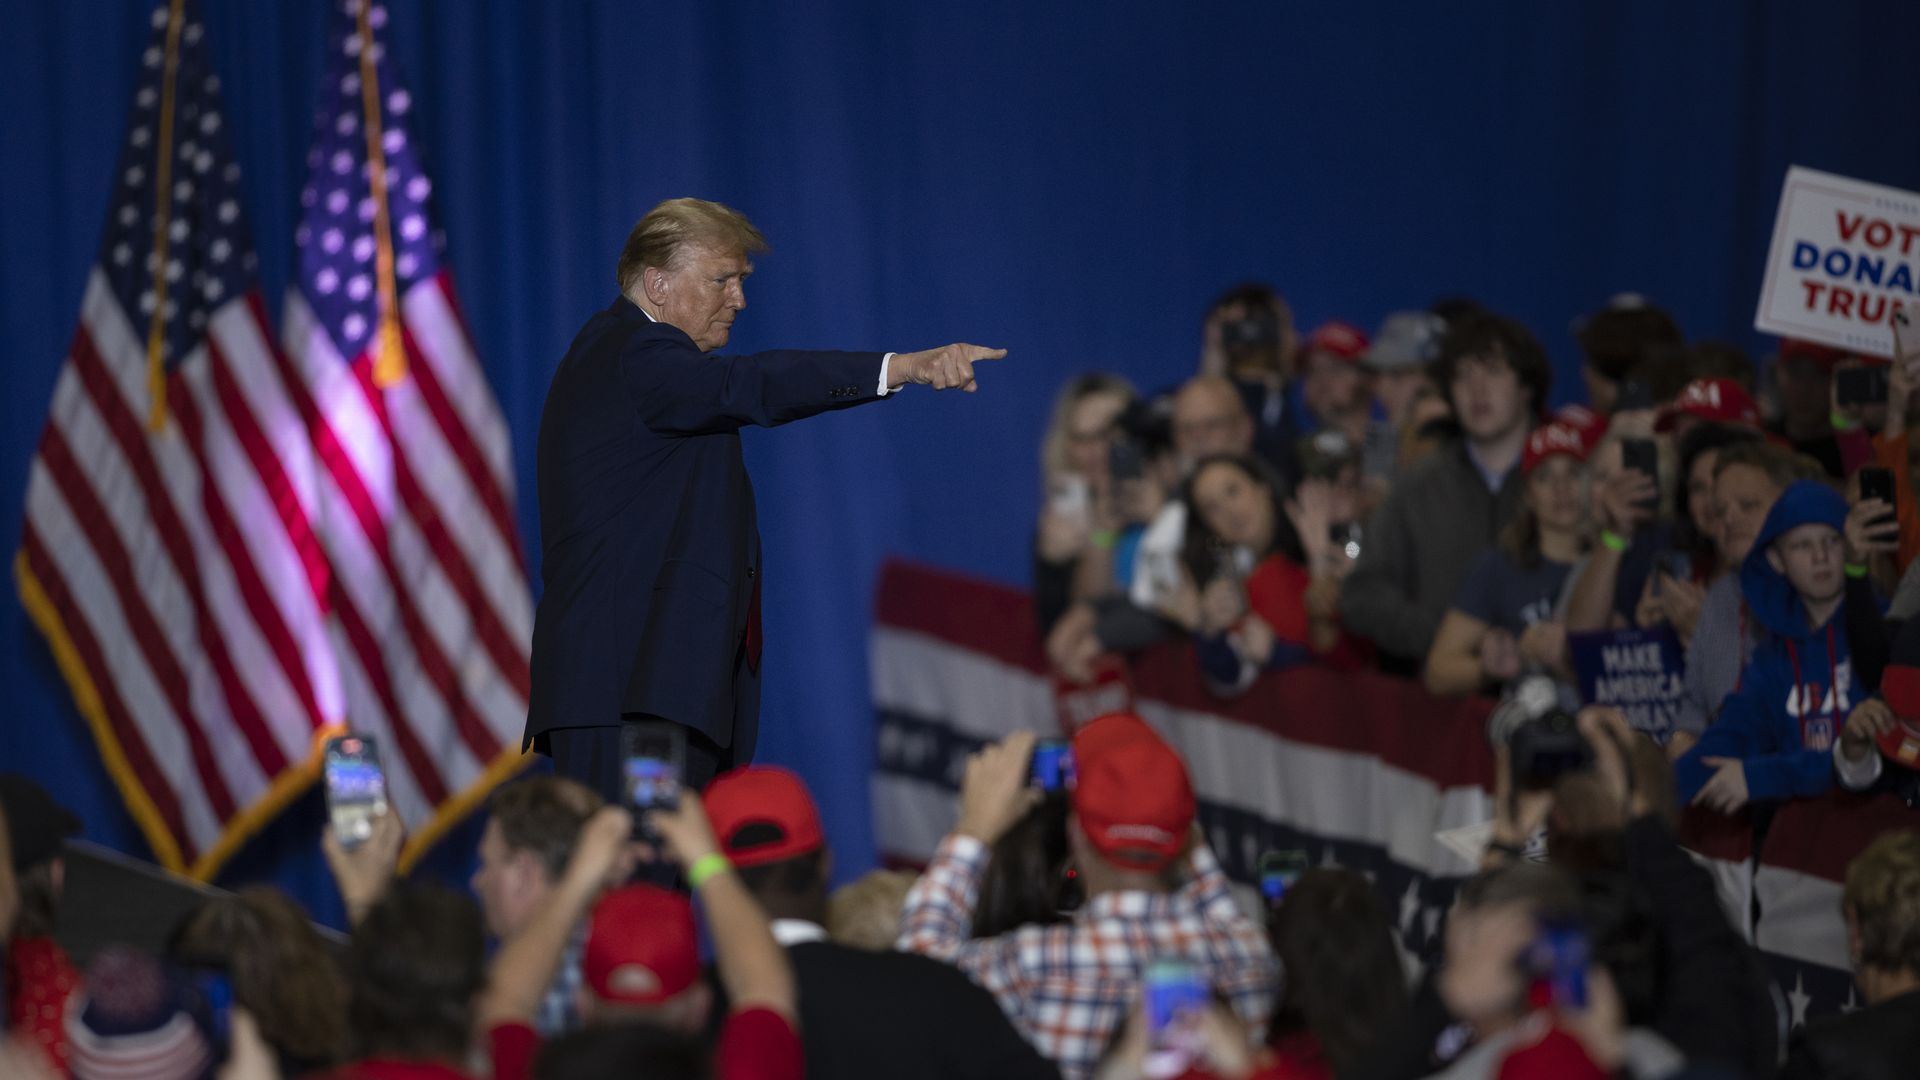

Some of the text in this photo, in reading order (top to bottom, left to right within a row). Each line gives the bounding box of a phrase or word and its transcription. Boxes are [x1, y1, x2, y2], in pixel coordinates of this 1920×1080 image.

[1791, 240, 1920, 297] DONA
[1601, 641, 1664, 673] MAKE
[1594, 671, 1681, 704] AMERICA
[1785, 681, 1851, 718] USA
